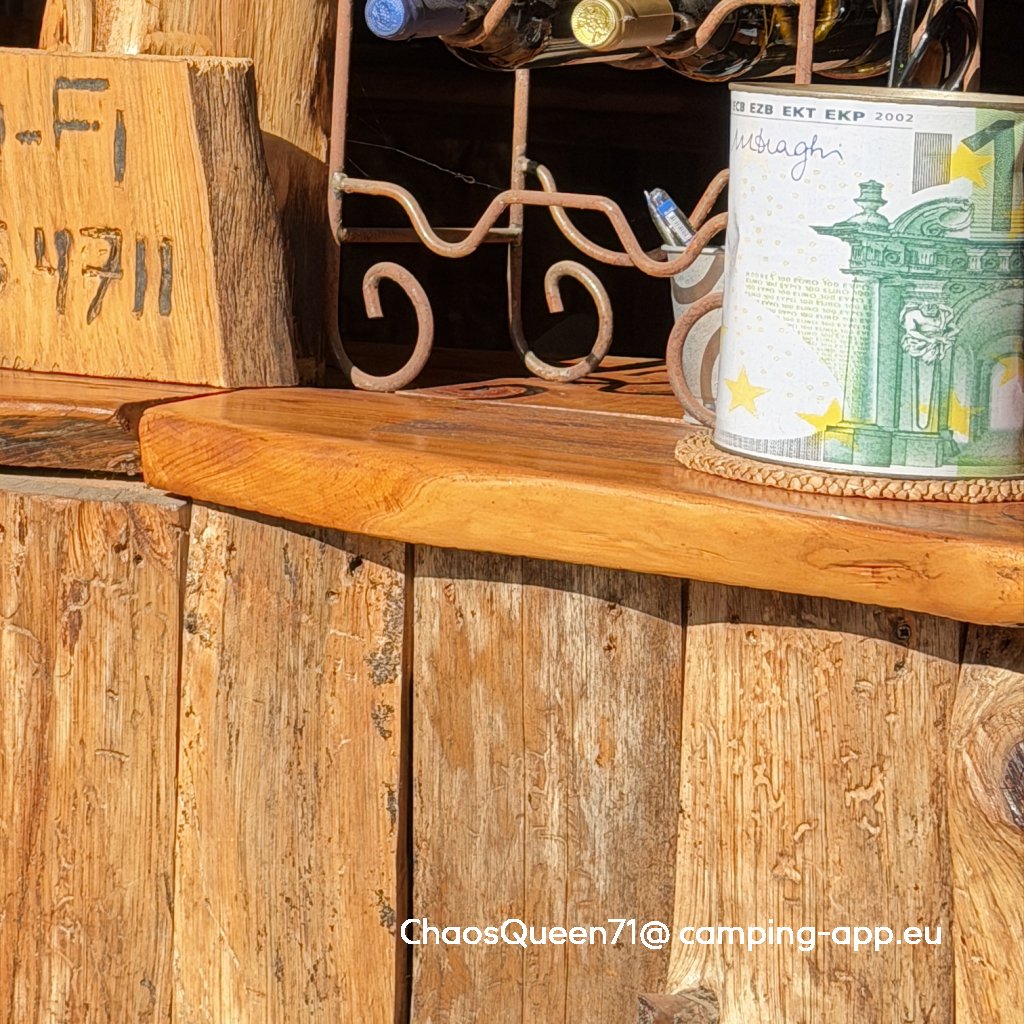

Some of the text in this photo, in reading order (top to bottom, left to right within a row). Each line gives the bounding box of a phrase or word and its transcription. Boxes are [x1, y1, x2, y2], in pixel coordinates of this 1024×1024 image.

[749, 102, 774, 115] EZB
[782, 106, 816, 119] EKT
[825, 108, 865, 122] EKP
[874, 111, 914, 123] 2002
